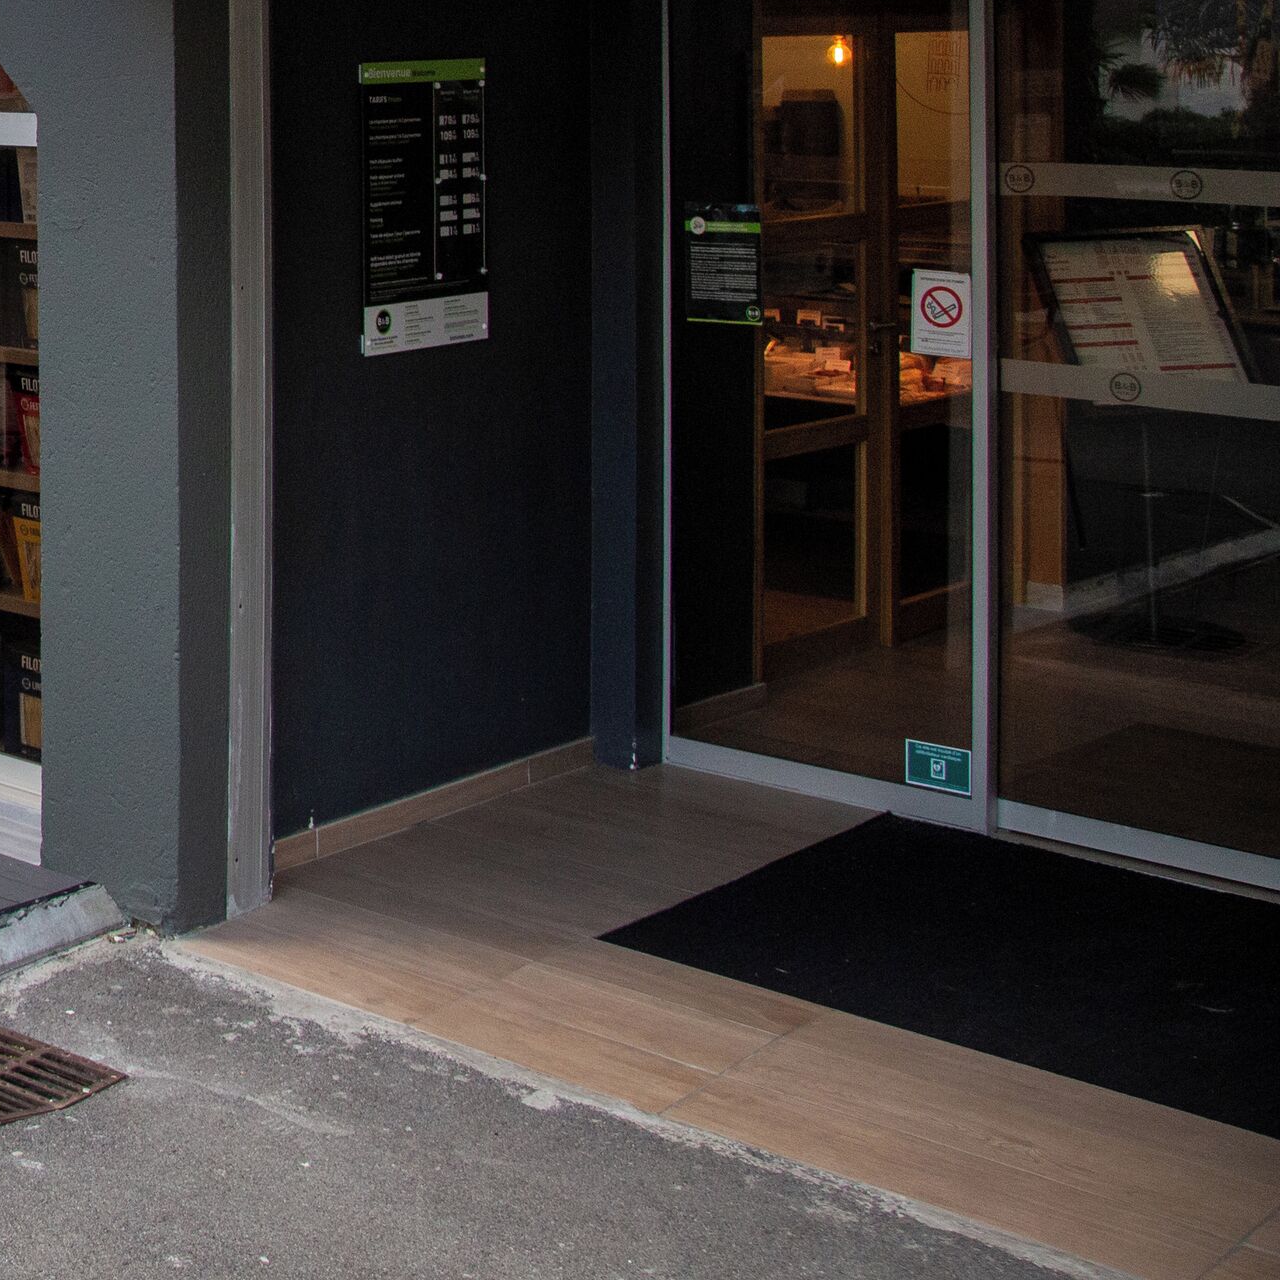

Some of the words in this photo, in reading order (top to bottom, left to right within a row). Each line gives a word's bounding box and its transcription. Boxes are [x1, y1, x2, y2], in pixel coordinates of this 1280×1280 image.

[20, 249, 38, 264] FILO
[21, 377, 39, 392] FILO
[1114, 380, 1137, 392] B&B
